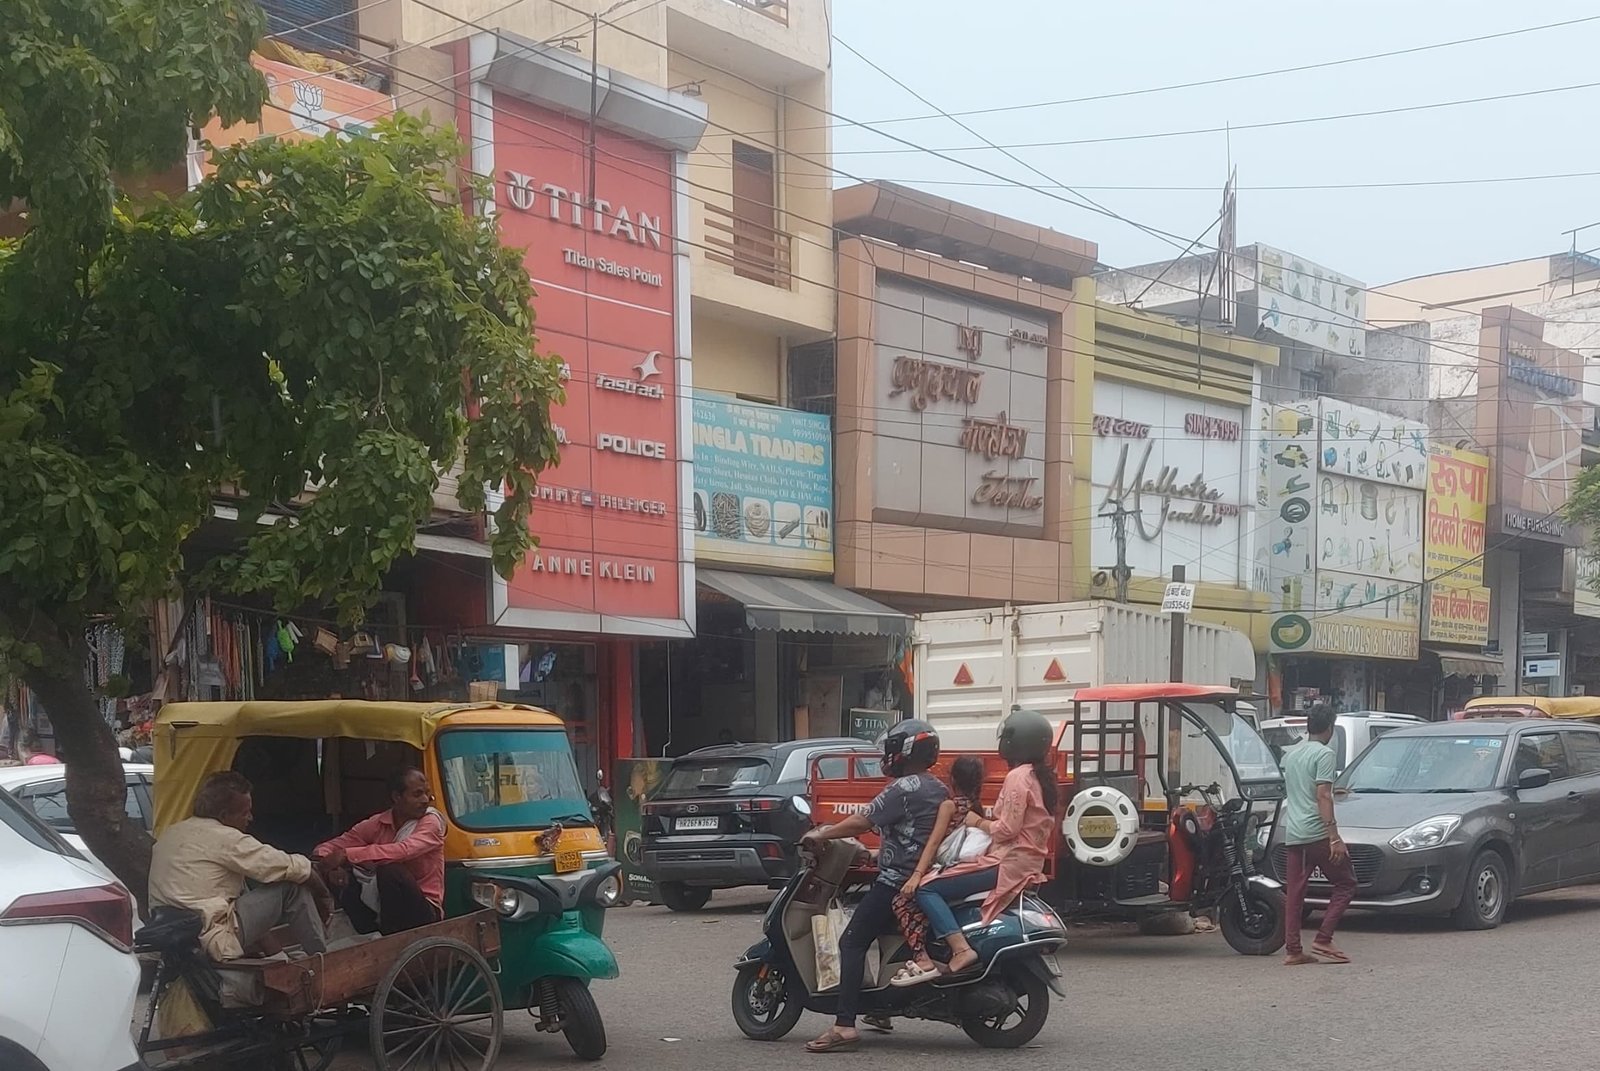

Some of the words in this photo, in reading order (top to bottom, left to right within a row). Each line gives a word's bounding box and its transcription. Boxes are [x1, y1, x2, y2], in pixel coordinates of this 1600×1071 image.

[542, 183, 661, 249] TITAN
[562, 248, 595, 269] Titan
[598, 258, 631, 278] Sales
[633, 265, 663, 287] Point
[596, 432, 666, 460] POLICE
[694, 421, 748, 455] INGLA
[750, 433, 824, 466] TRADERS
[1430, 455, 1488, 504] रूपा
[530, 486, 583, 504] OMMY
[600, 494, 667, 515] HILFIGER
[1428, 498, 1460, 549] टिक्की
[1506, 512, 1527, 531] HOME
[1527, 517, 1565, 538] FURNISHING
[532, 554, 592, 576] ANNE
[600, 560, 655, 583] KLEIN
[1432, 594, 1449, 618] रूपा
[1450, 587, 1472, 620] टिक्की
[1314, 621, 1341, 651] KAKA
[1342, 624, 1371, 655] TOOLS
[864, 718, 888, 729] TITAN
